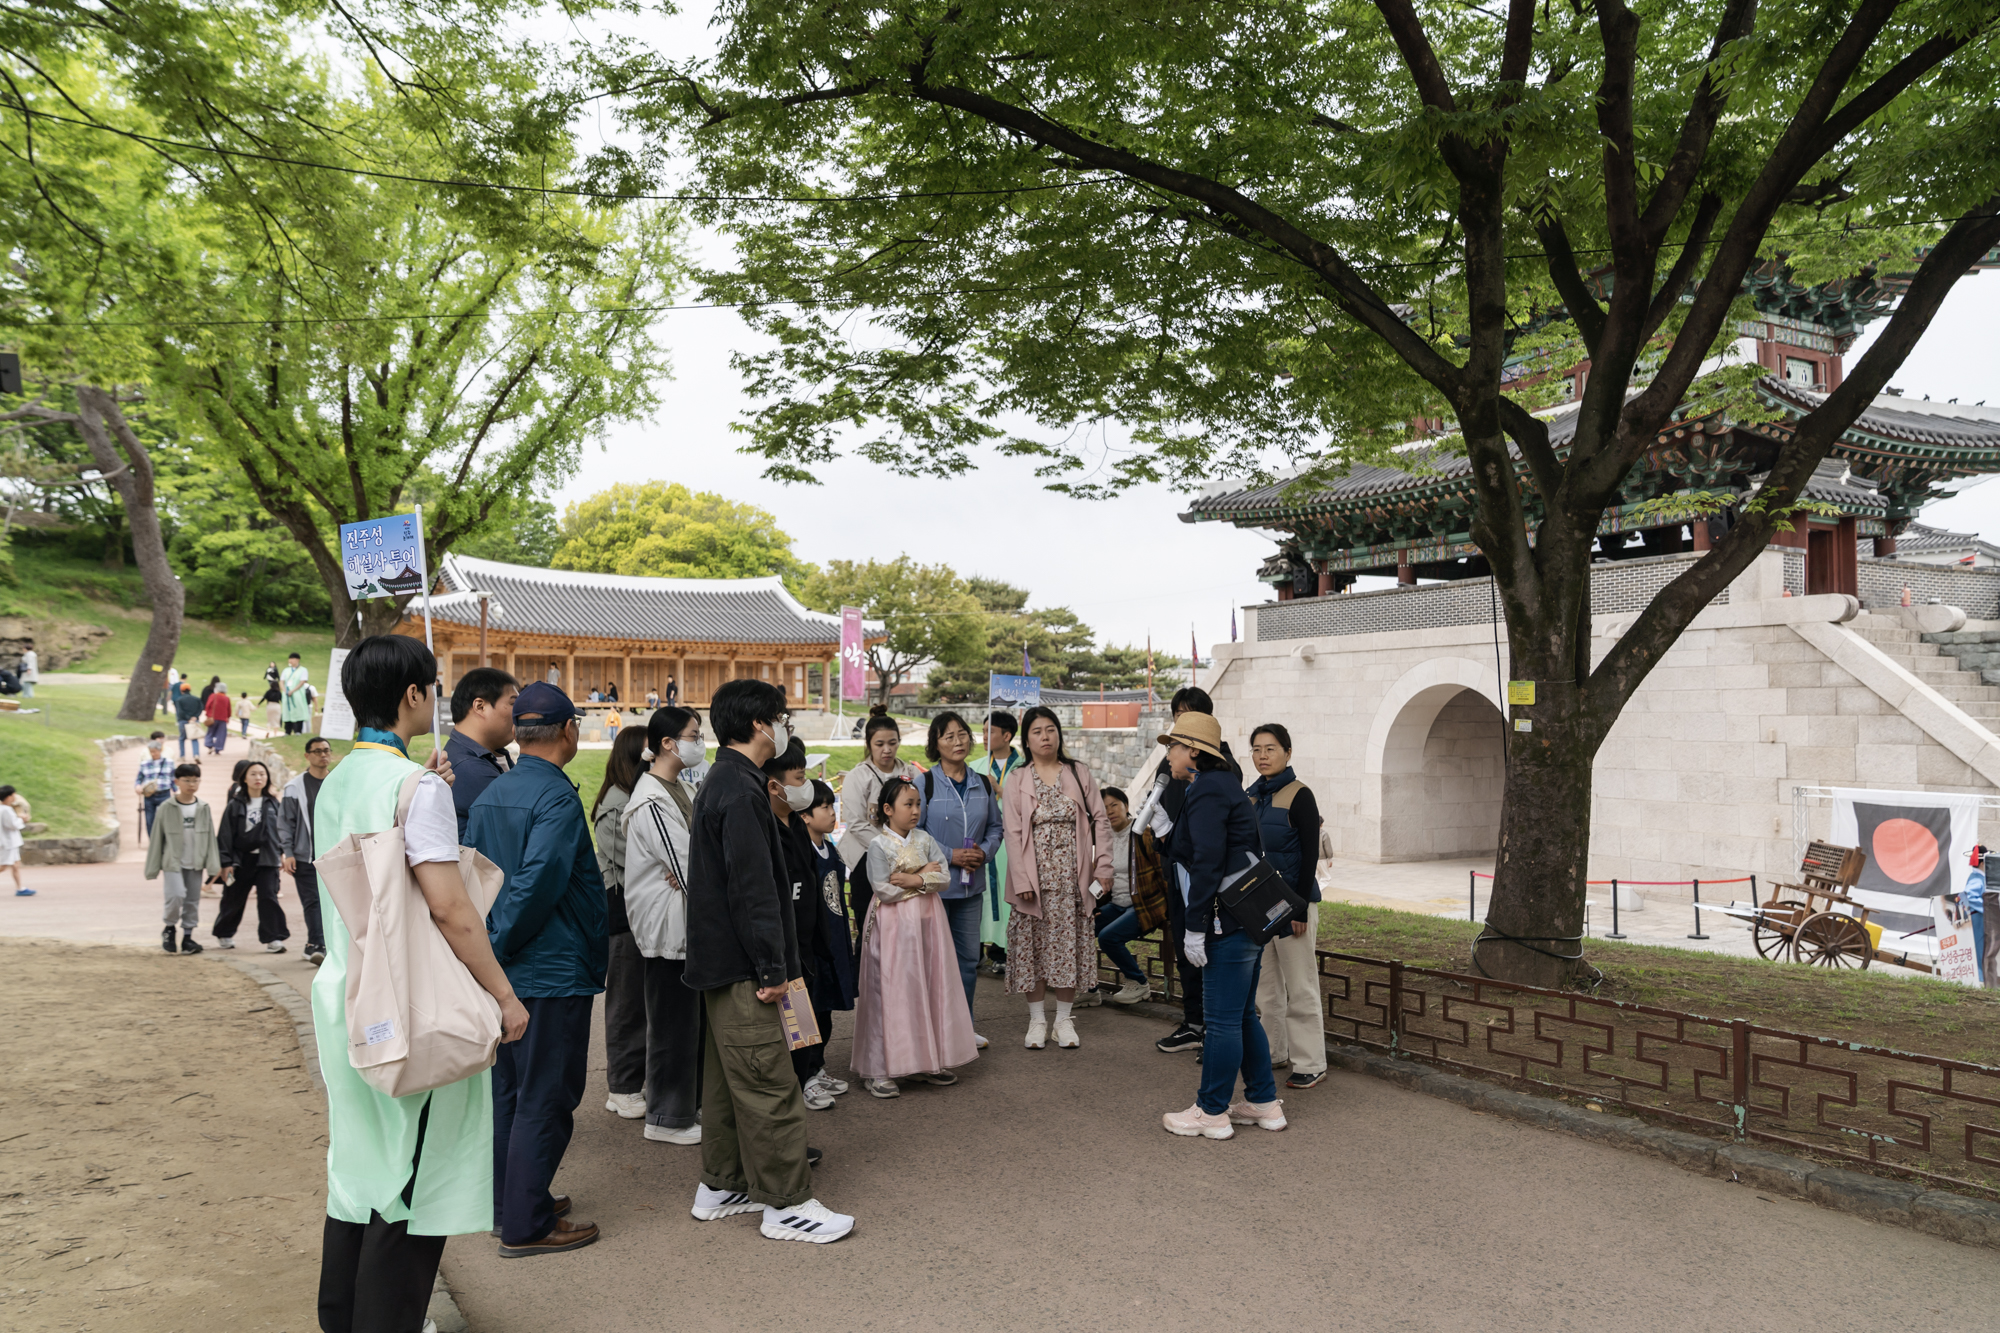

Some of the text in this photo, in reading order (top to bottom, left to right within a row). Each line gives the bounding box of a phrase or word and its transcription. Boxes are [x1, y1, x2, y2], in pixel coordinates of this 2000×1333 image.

[346, 525, 383, 550] 진주성
[347, 546, 416, 575] 해설사 투어
[844, 642, 862, 668] 악
[1014, 678, 1038, 688] 진주성
[1941, 947, 1972, 965] 수성중군영
[1951, 963, 1975, 979] 교대의식
